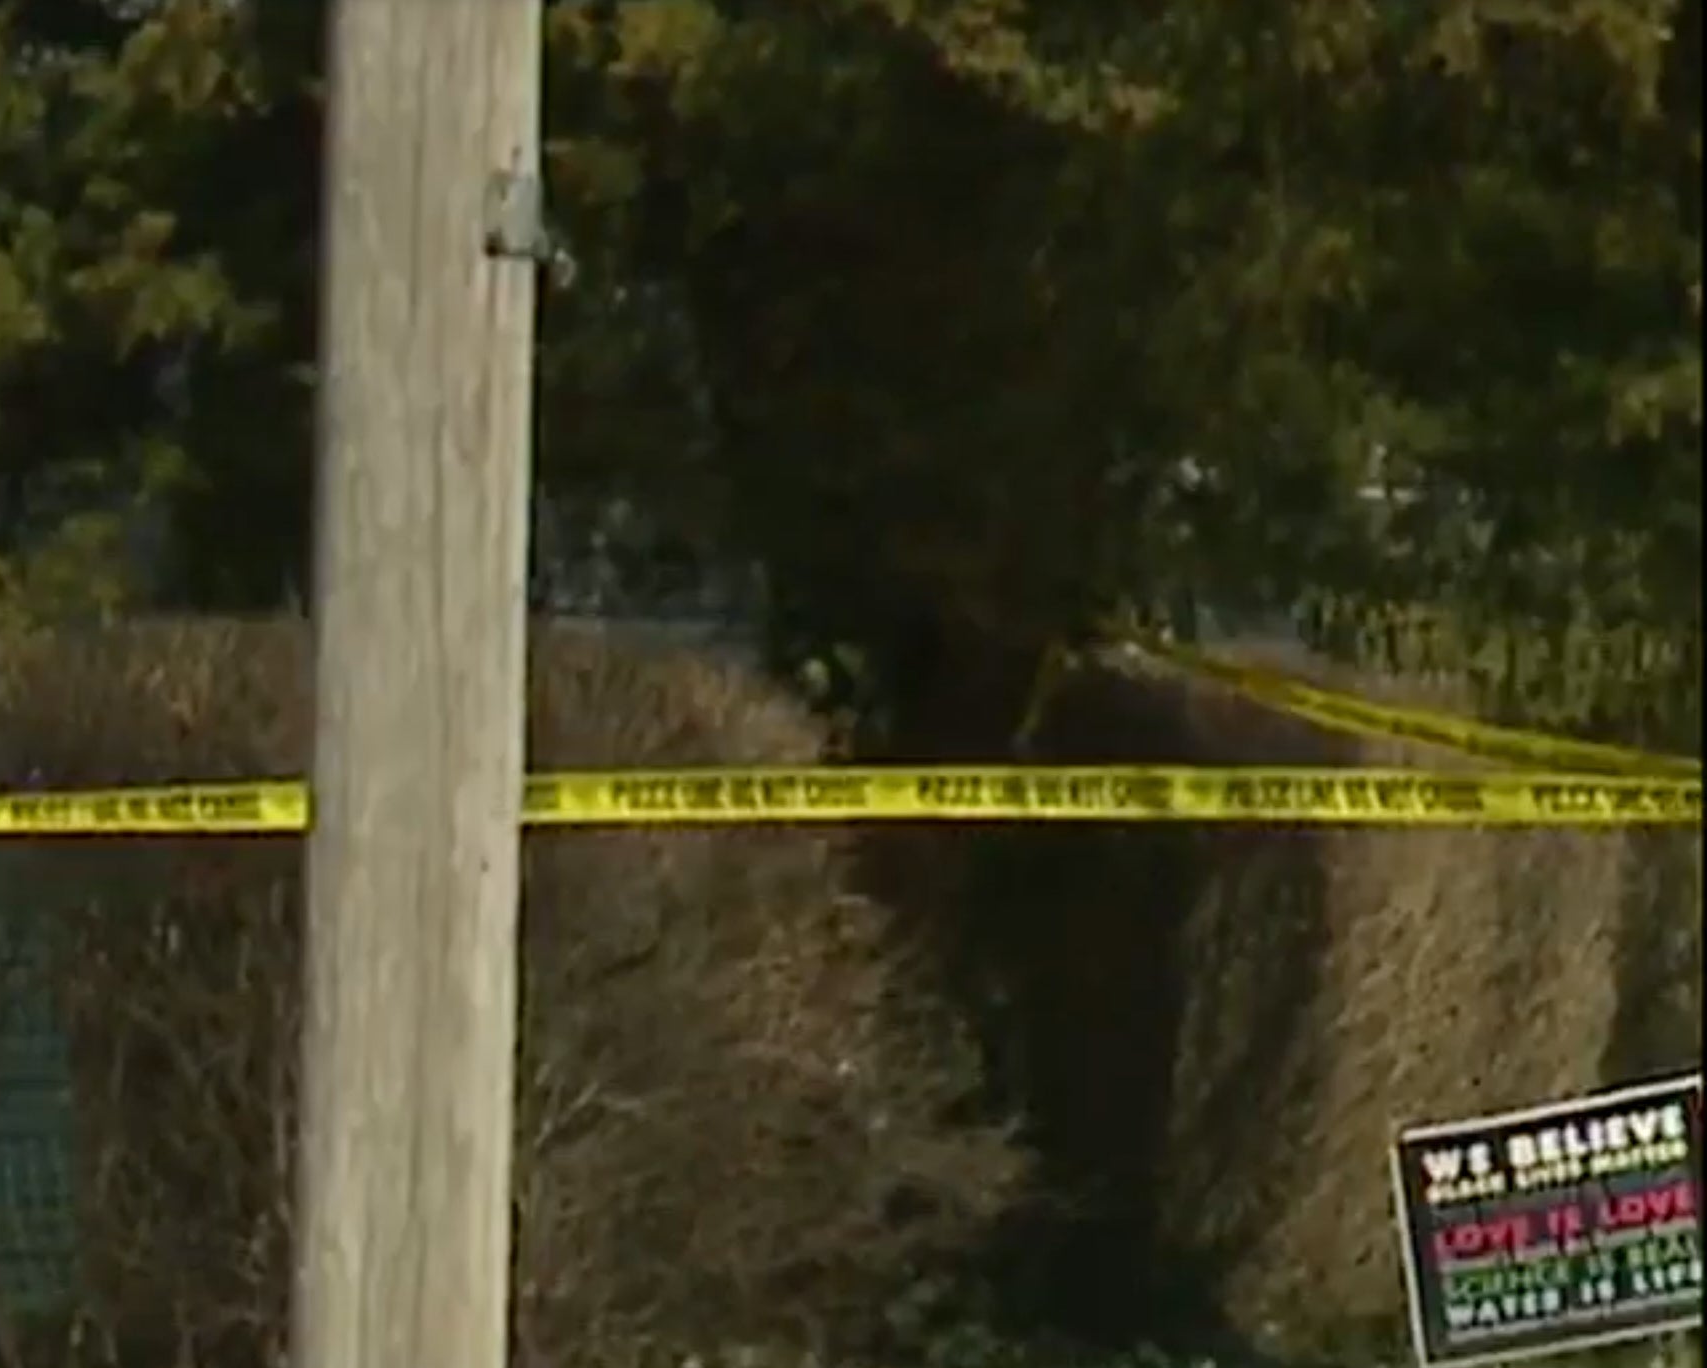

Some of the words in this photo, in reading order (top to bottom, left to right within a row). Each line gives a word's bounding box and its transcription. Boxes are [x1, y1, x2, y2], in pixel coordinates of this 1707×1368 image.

[1422, 1143, 1491, 1181] WE
[1507, 1105, 1687, 1166] BELIEVE
[1590, 1139, 1688, 1174] MATTER
[1435, 1214, 1529, 1253] LOVE
[1546, 1204, 1581, 1235] IS
[1602, 1181, 1696, 1227] LOVE
[1445, 1287, 1561, 1330] WATER
[1580, 1277, 1615, 1306] IS
[1449, 1257, 1570, 1298] SCIENCE
